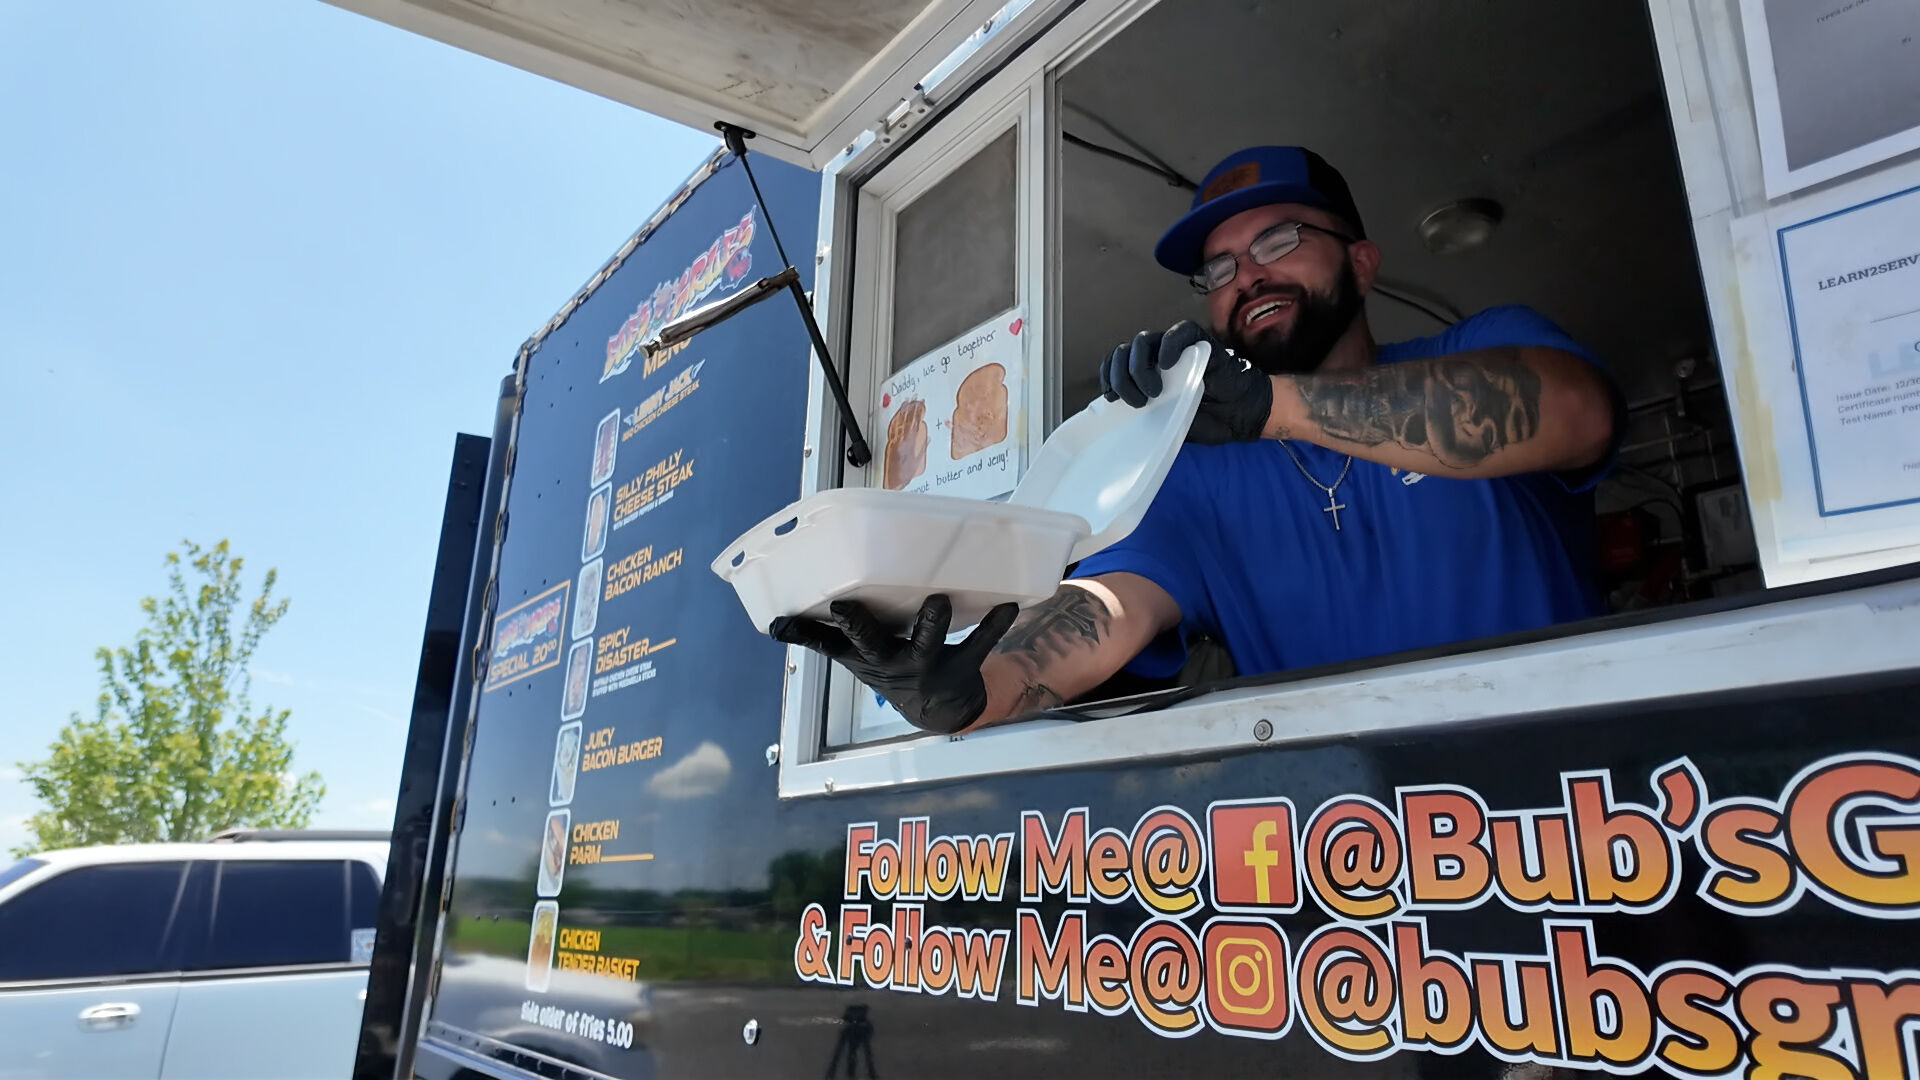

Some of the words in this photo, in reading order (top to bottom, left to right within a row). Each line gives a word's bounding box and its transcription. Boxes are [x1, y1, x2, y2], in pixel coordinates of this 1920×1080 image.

[1818, 253, 1920, 291] LEARN2SERV
[891, 373, 920, 397] Daddy,
[923, 363, 936, 377] we
[941, 355, 951, 374] go
[957, 329, 997, 359] together
[613, 484, 656, 522] CHEESE
[656, 458, 695, 498] STEAK
[615, 472, 645, 505] SILLY
[643, 447, 684, 487] PHILLY
[936, 466, 963, 486] butter
[967, 458, 983, 475] and
[604, 569, 642, 602] BACON
[642, 547, 683, 584] RANCH
[606, 544, 653, 582] CHICKEN
[594, 637, 651, 675] DISASTER
[597, 625, 631, 655] SPICY
[489, 651, 529, 683] SPECIAL
[581, 747, 617, 773] BACON
[616, 736, 664, 766] BURGER
[584, 726, 616, 752] JUICY
[572, 819, 620, 844] CHICKEN
[569, 844, 602, 866] PARM
[846, 818, 1012, 900] Follow
[559, 927, 601, 952] CHICKEN
[795, 903, 835, 983] &
[838, 903, 1011, 1001] Follow
[558, 951, 597, 974] TENDER
[595, 955, 640, 982] BASKET
[539, 1005, 566, 1030] order
[565, 1010, 580, 1034] of
[579, 1011, 605, 1042] fries
[606, 1018, 634, 1049] 5.00
